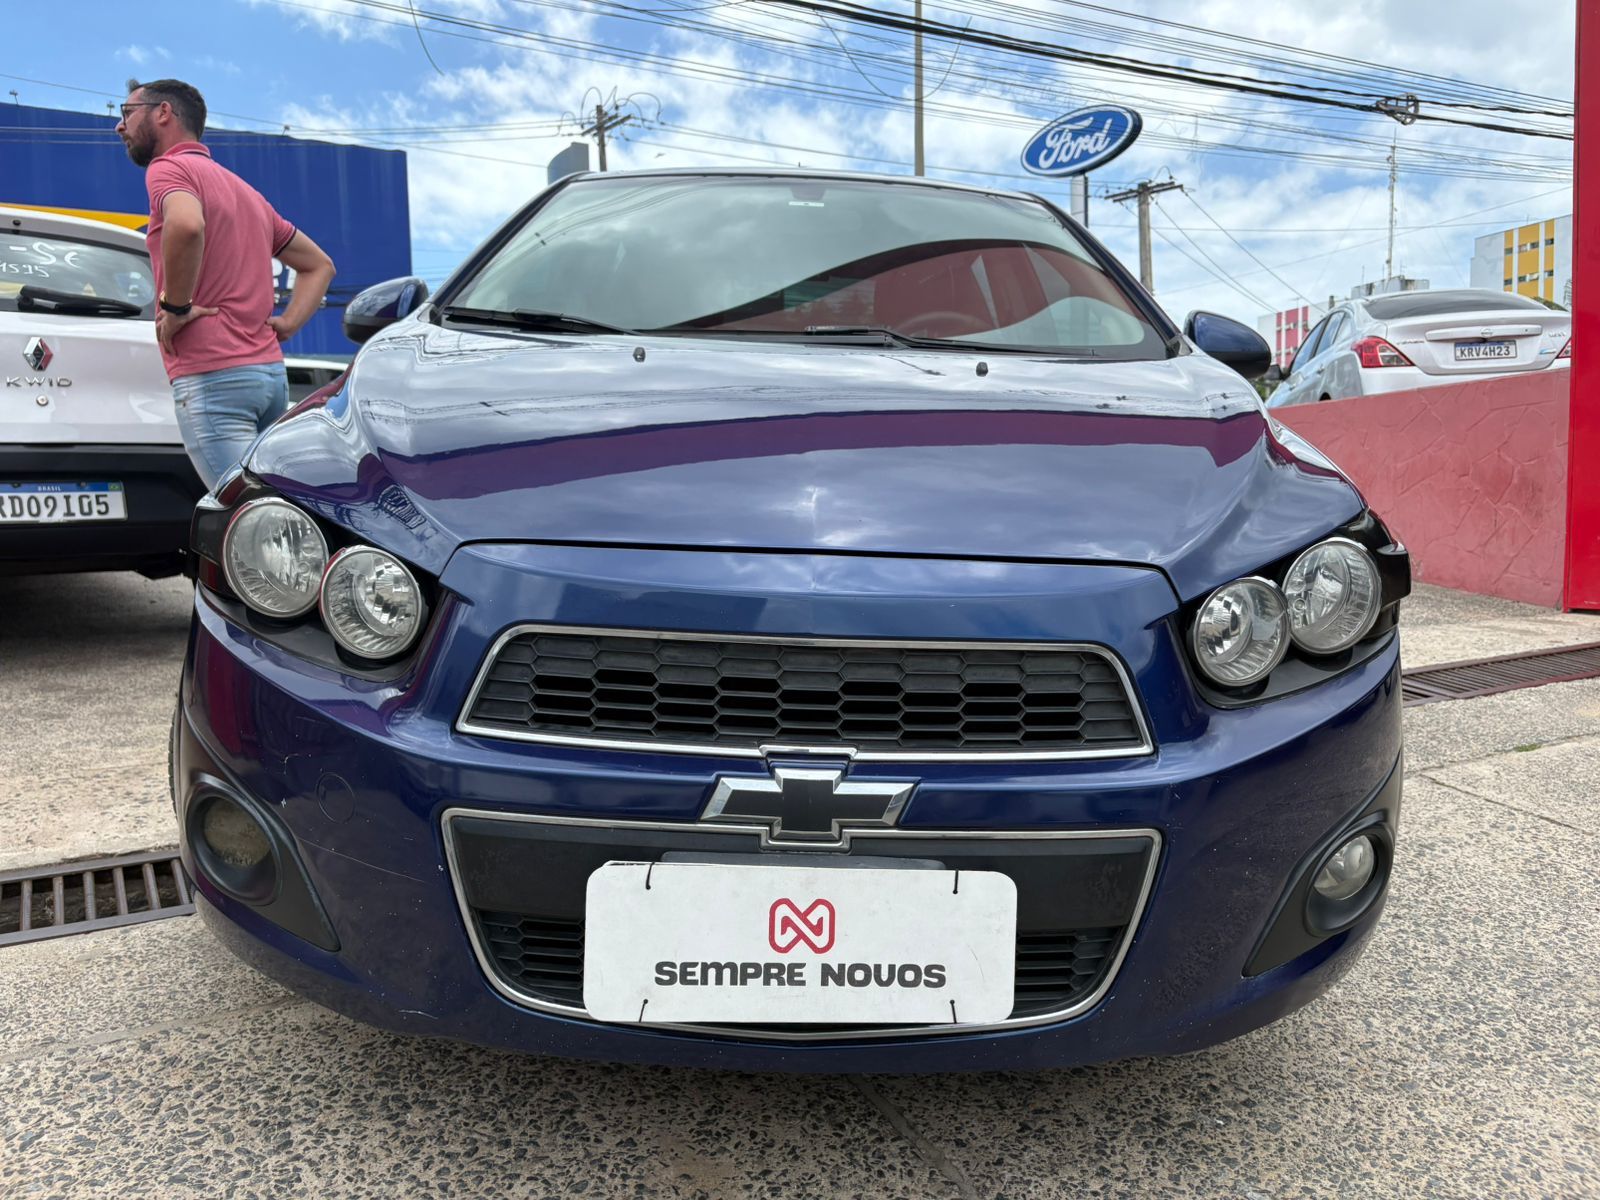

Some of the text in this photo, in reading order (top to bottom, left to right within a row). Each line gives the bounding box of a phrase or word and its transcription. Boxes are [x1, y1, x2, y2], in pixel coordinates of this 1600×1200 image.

[1038, 116, 1113, 169] Ford
[1460, 345, 1511, 358] KRV4H23
[6, 376, 73, 388] KWID
[654, 961, 947, 989] SEMPRE NOVOS
